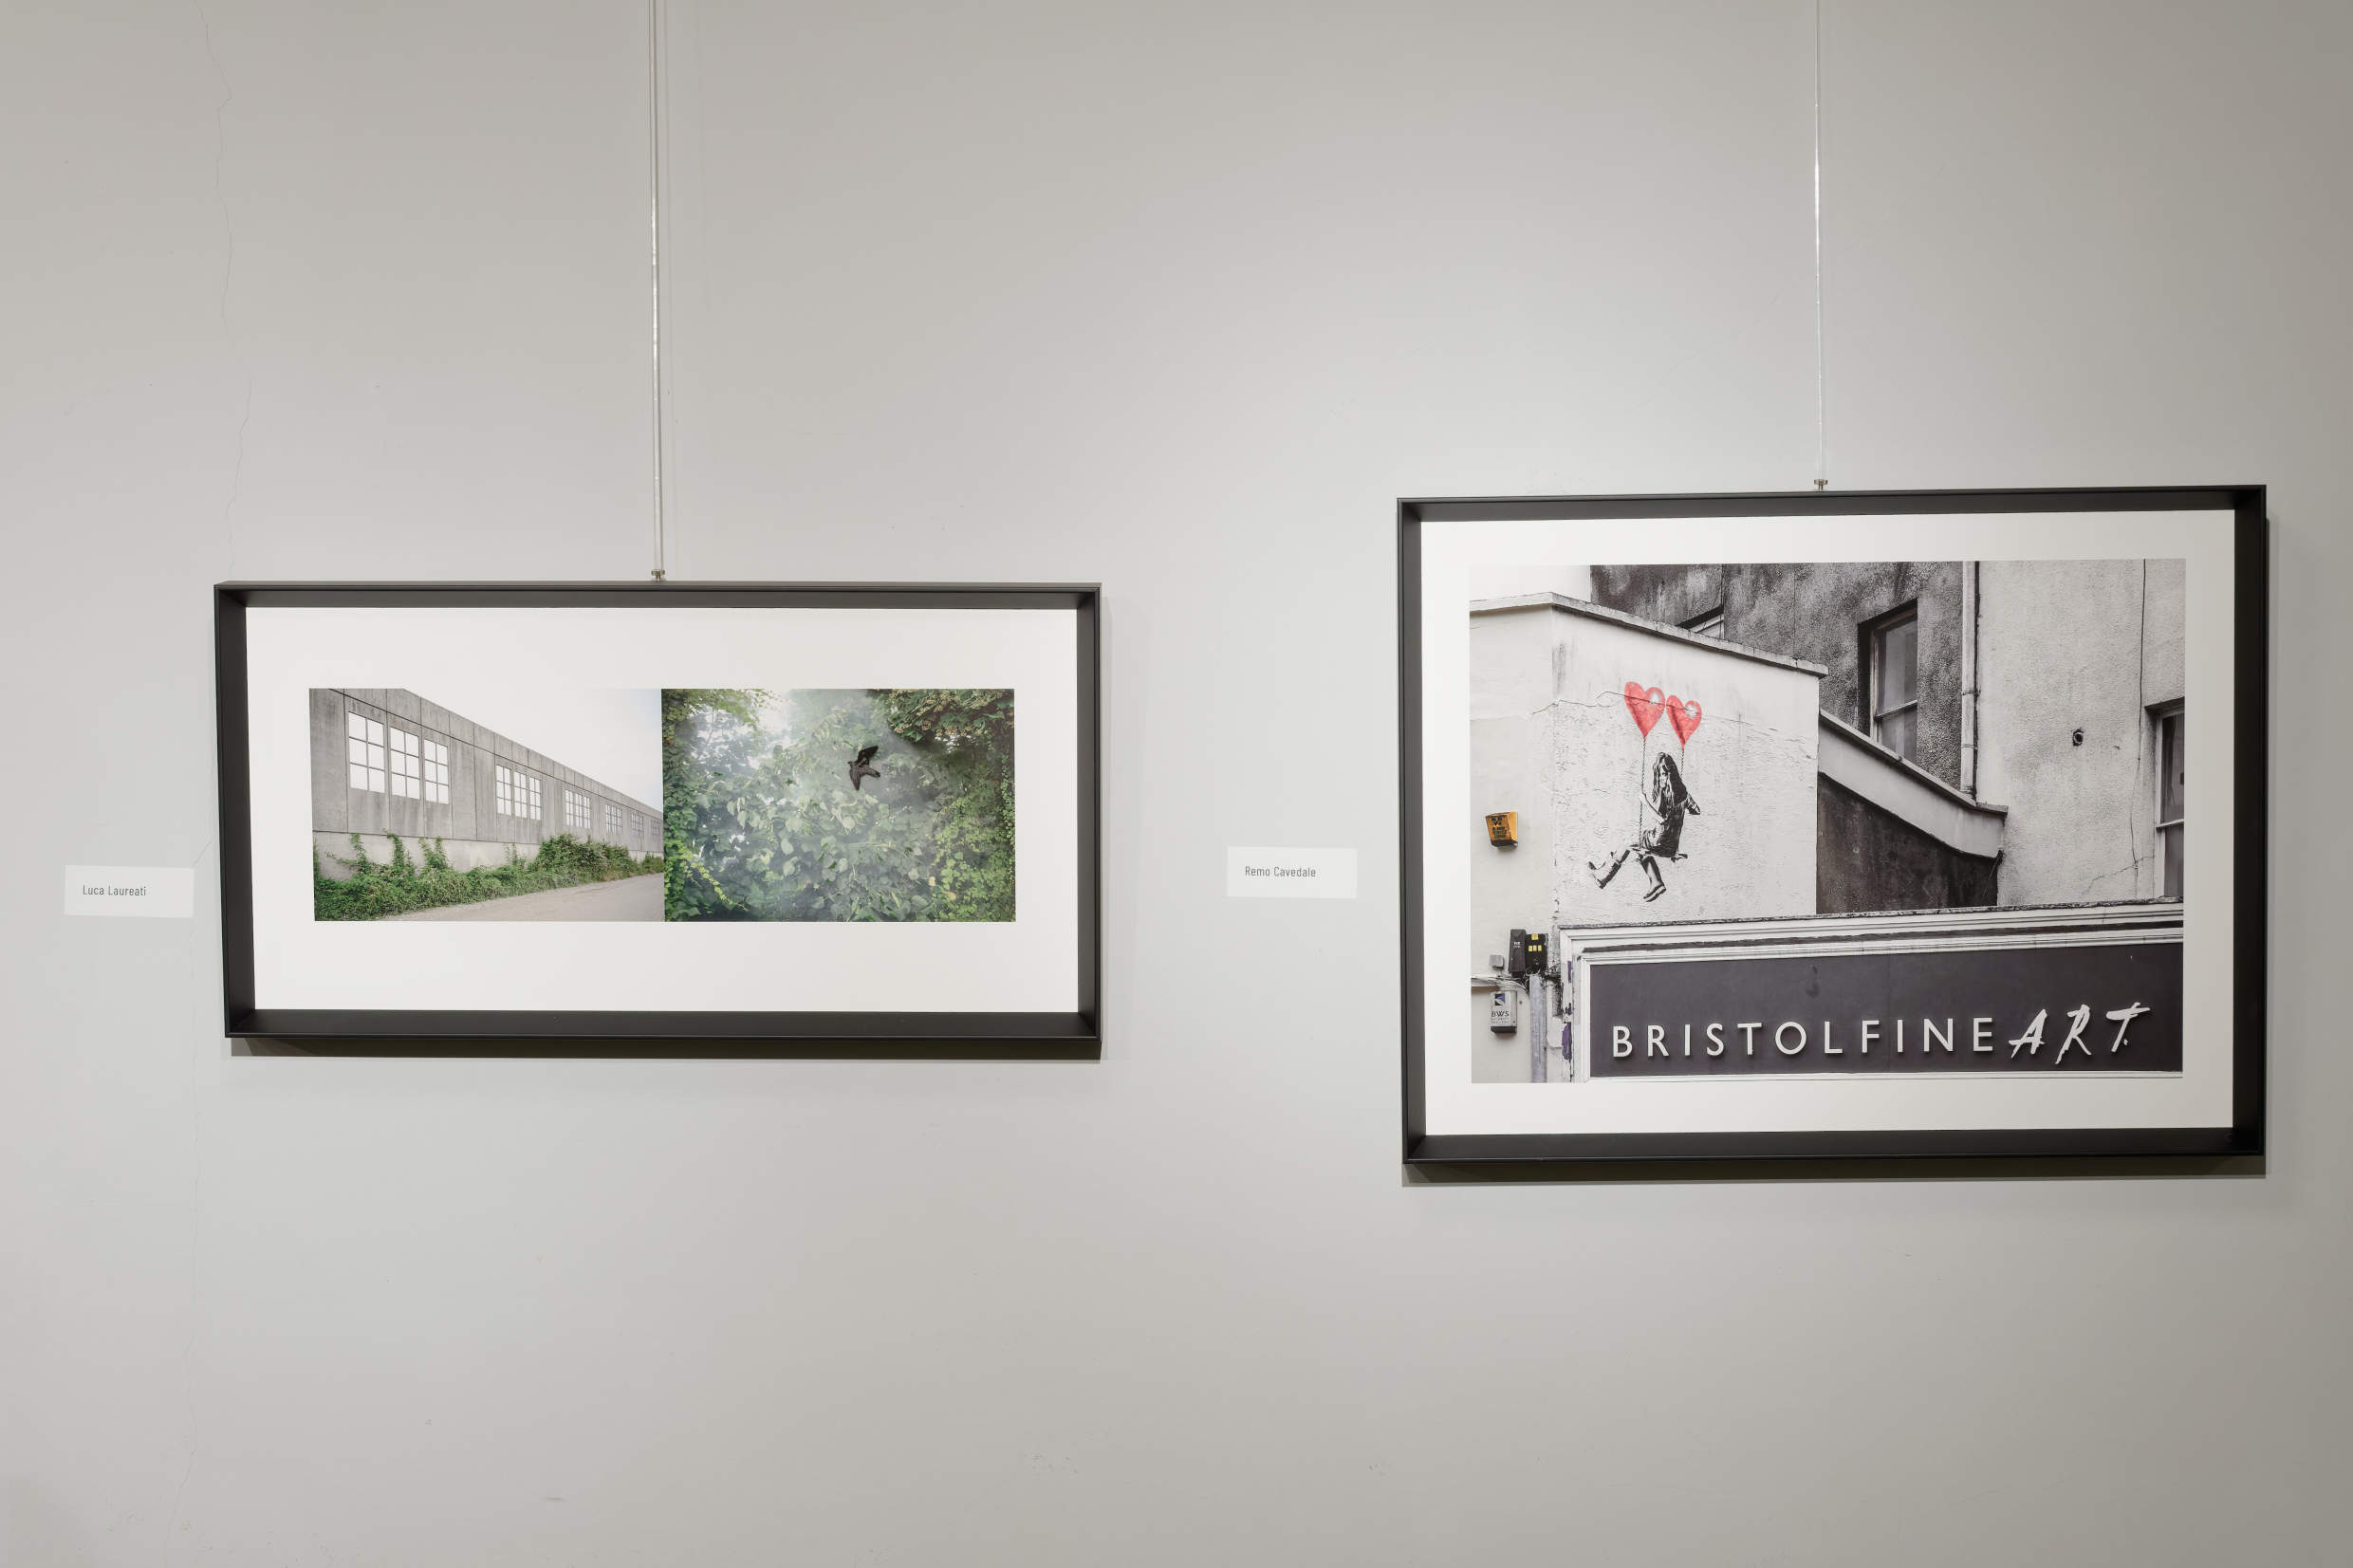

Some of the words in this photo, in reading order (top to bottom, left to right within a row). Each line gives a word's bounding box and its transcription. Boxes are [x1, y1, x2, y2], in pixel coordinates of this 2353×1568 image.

[1245, 865, 1270, 876] Remo
[1273, 866, 1316, 877] Cavedale
[83, 884, 105, 895] Luca
[107, 885, 146, 896] Laureati
